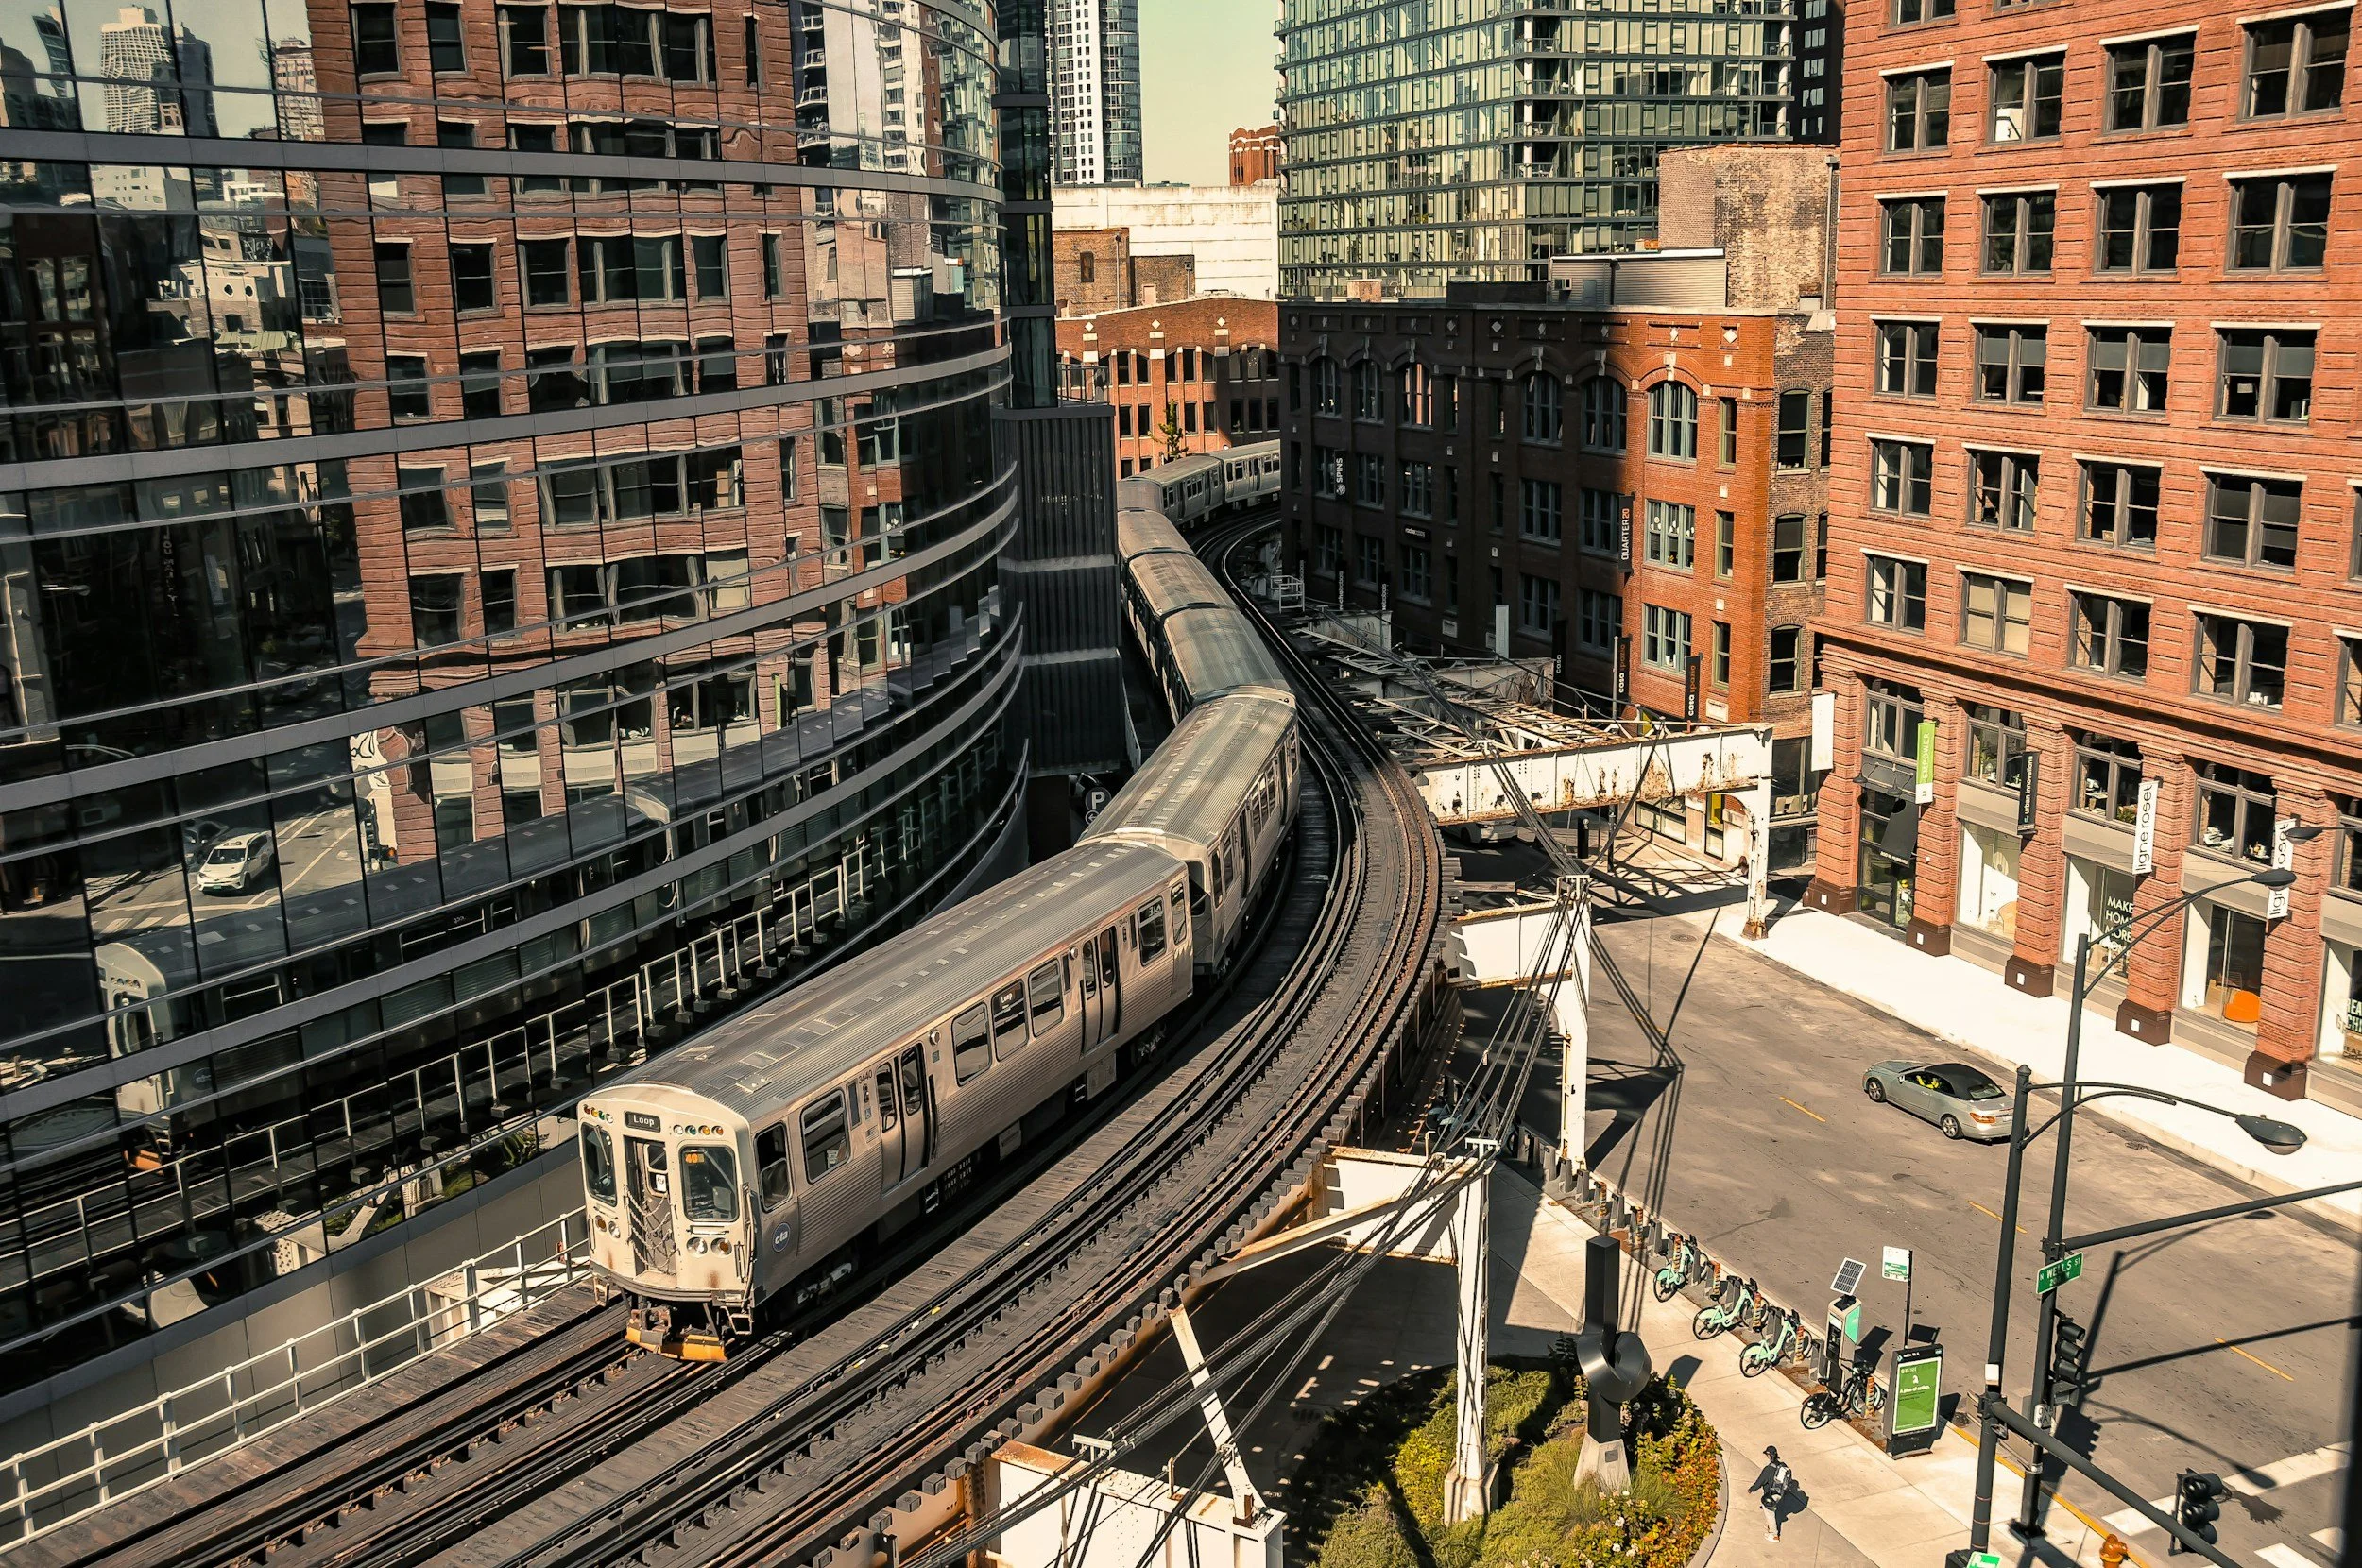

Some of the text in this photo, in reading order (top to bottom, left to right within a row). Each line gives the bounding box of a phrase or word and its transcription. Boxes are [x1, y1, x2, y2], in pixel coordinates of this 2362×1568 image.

[1621, 508, 1630, 561] QUARTER 20
[2026, 755, 2034, 793] innovations
[1091, 791, 1106, 810] P
[2135, 784, 2153, 871] ligne roset
[2107, 895, 2134, 914] MAKE
[858, 1069, 873, 1084] 3440
[633, 1115, 655, 1127] Loop
[774, 1229, 789, 1245] cta
[2039, 1256, 2081, 1281] N WELLS ST
